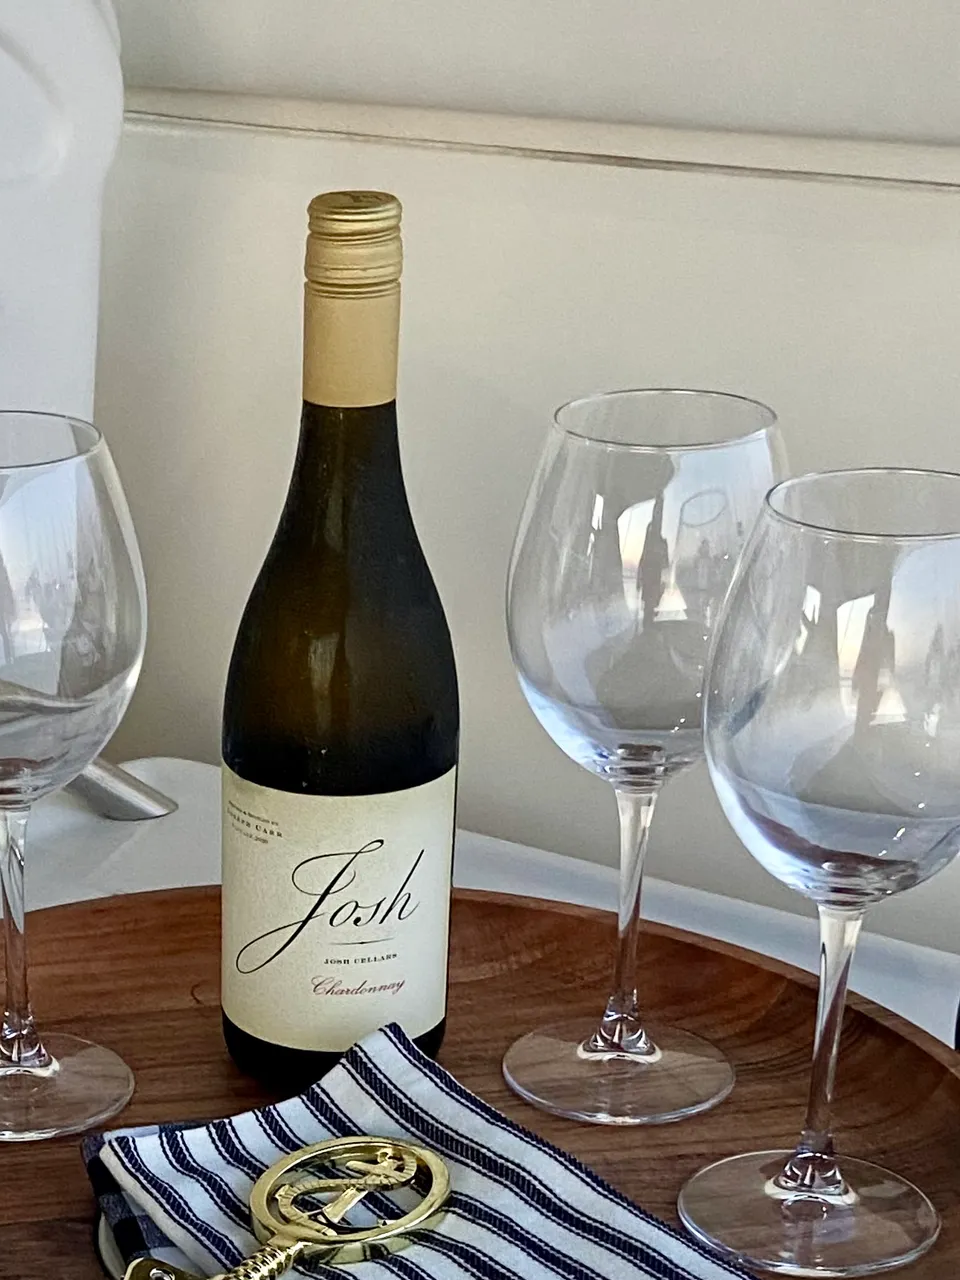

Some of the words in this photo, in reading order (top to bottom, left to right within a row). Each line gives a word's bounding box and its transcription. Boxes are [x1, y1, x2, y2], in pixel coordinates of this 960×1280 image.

[235, 839, 425, 974] Josh
[323, 957, 350, 965] JOSH
[353, 952, 398, 965] CELLARS
[311, 976, 406, 996] Chardonnay
